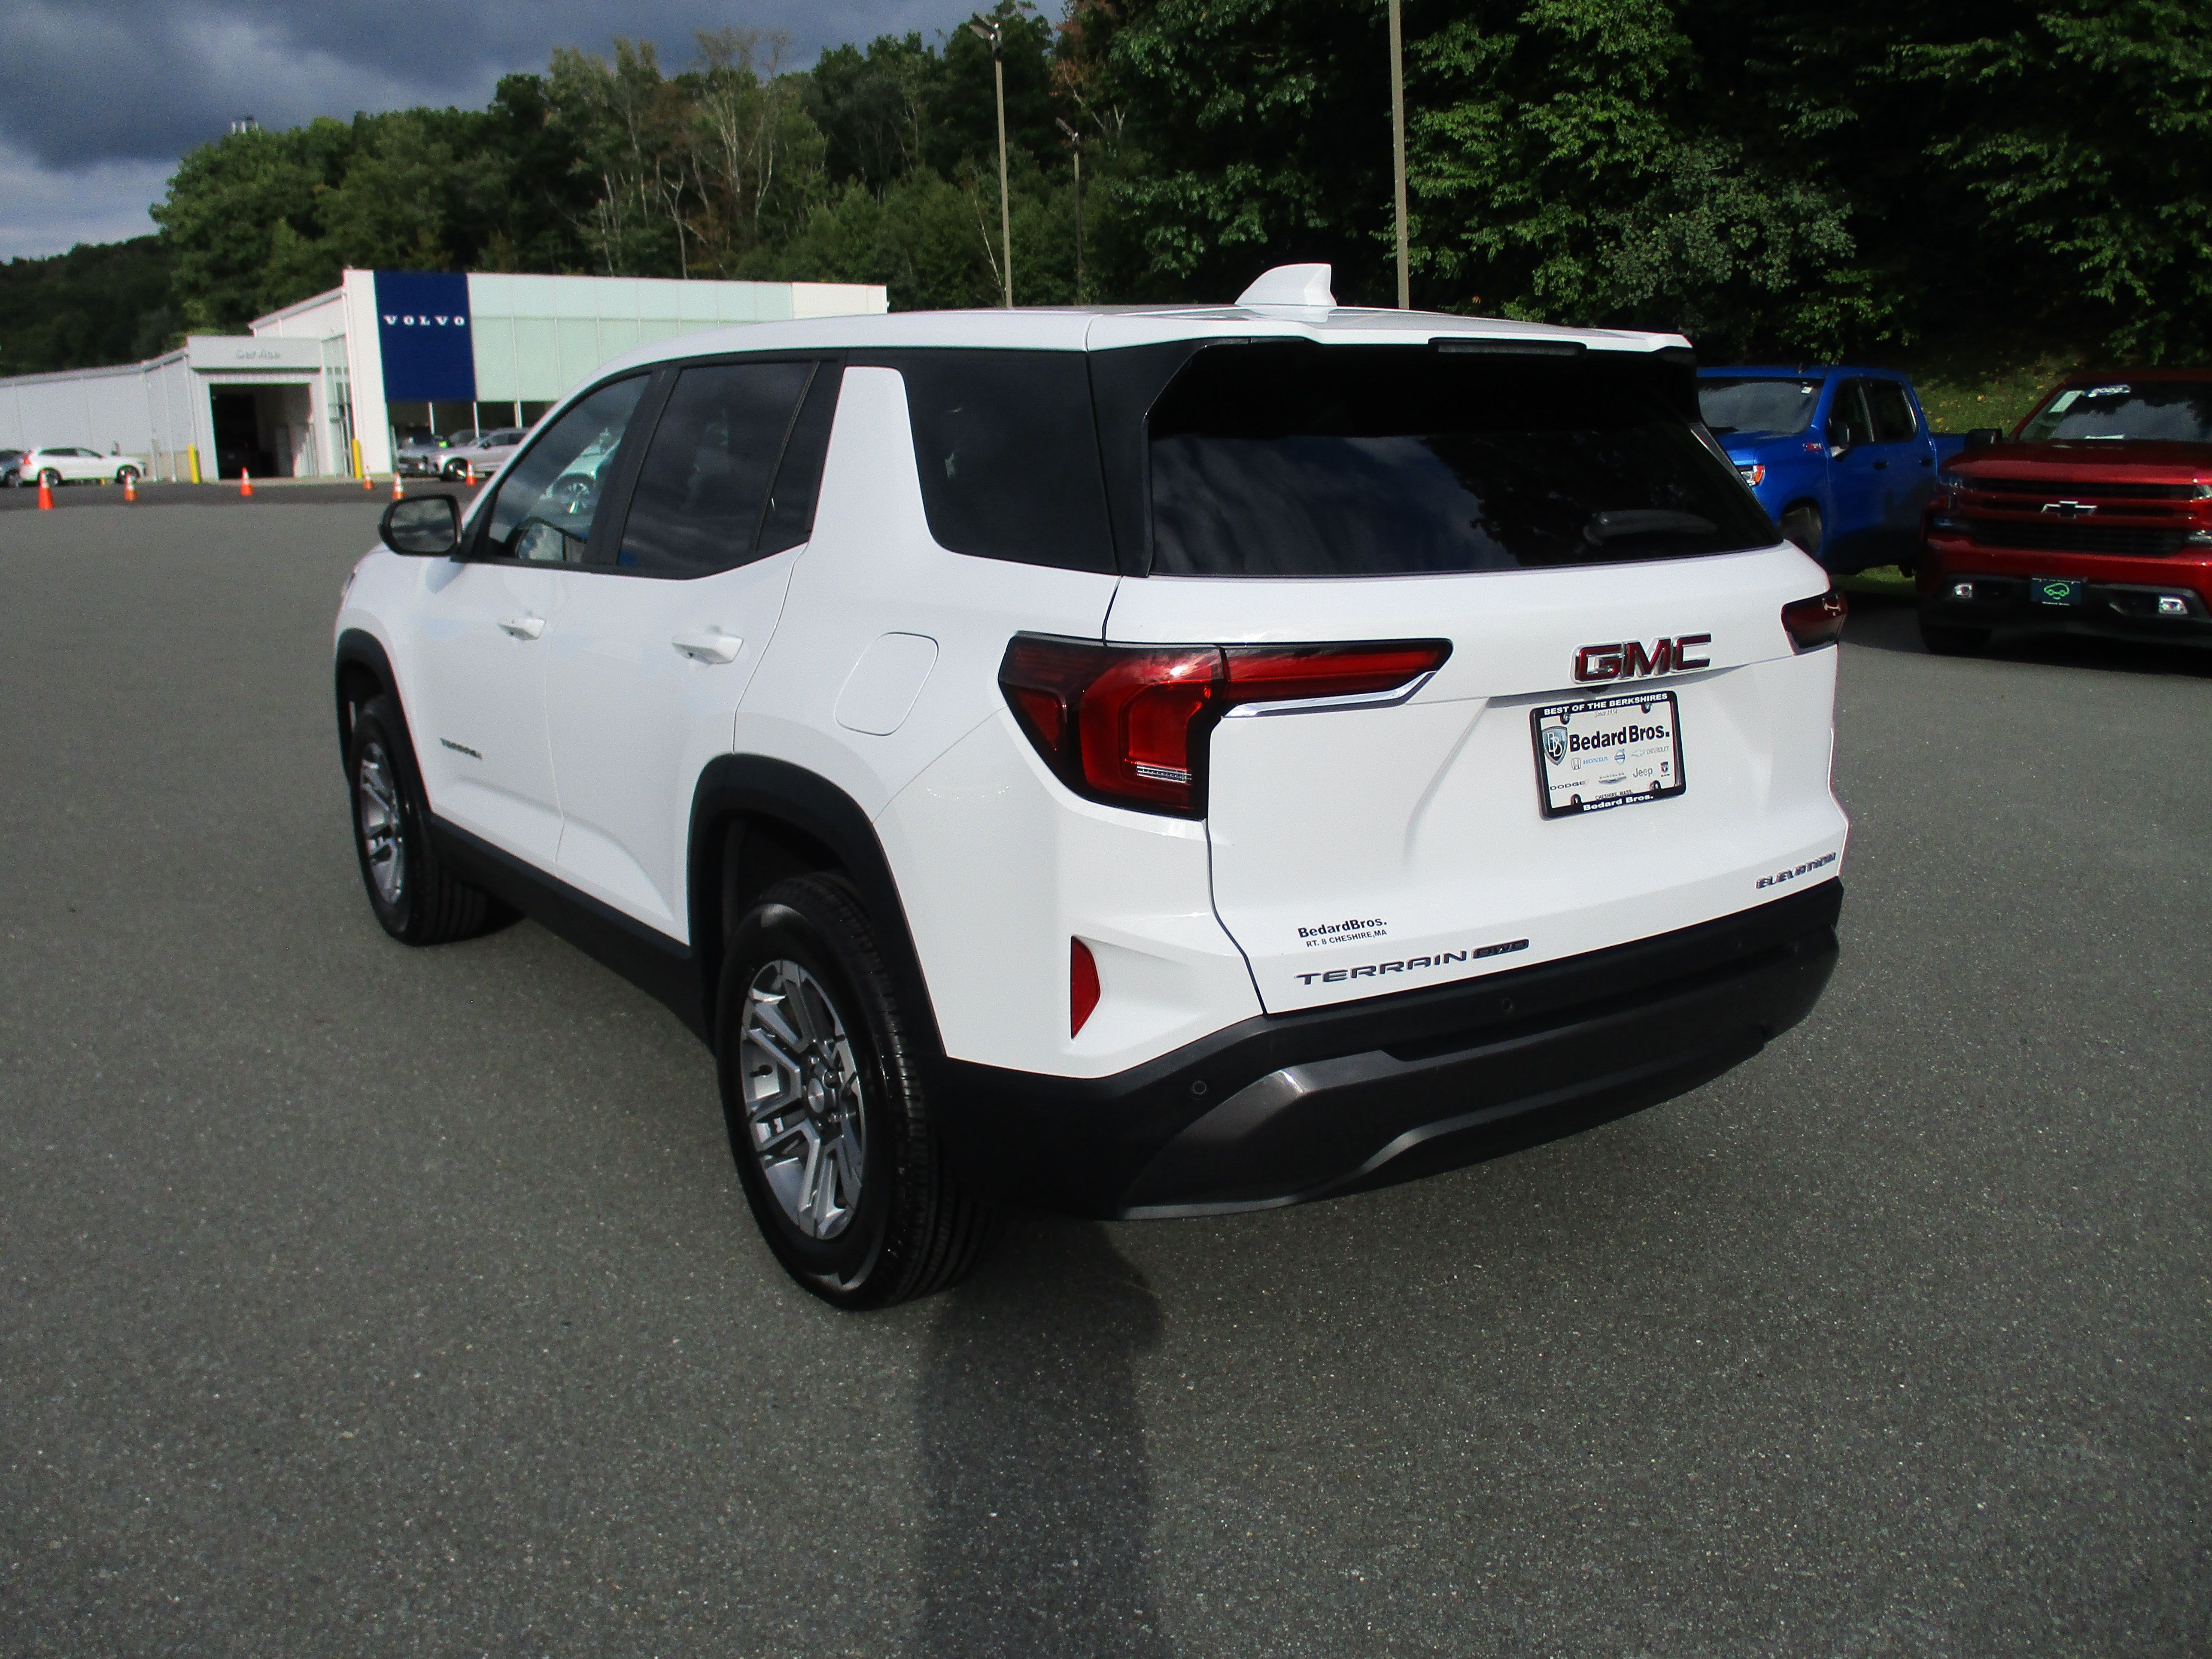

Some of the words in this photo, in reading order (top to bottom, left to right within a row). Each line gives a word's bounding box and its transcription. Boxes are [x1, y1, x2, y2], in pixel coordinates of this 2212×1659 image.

[383, 314, 465, 327] VOLVO
[1571, 632, 1712, 684] GMC
[1544, 707, 1569, 715] BEST
[1588, 701, 1607, 709] THE
[1609, 693, 1668, 707] BERKSHIRES
[1583, 756, 1609, 765] HONDA
[1633, 768, 1653, 778] Jeep
[1550, 781, 1586, 790] DODGE
[1583, 797, 1623, 811] Bedard
[1626, 794, 1653, 804] Bros.
[1756, 852, 1836, 889] ELEVATION
[1294, 949, 1467, 985] TERRAIN
